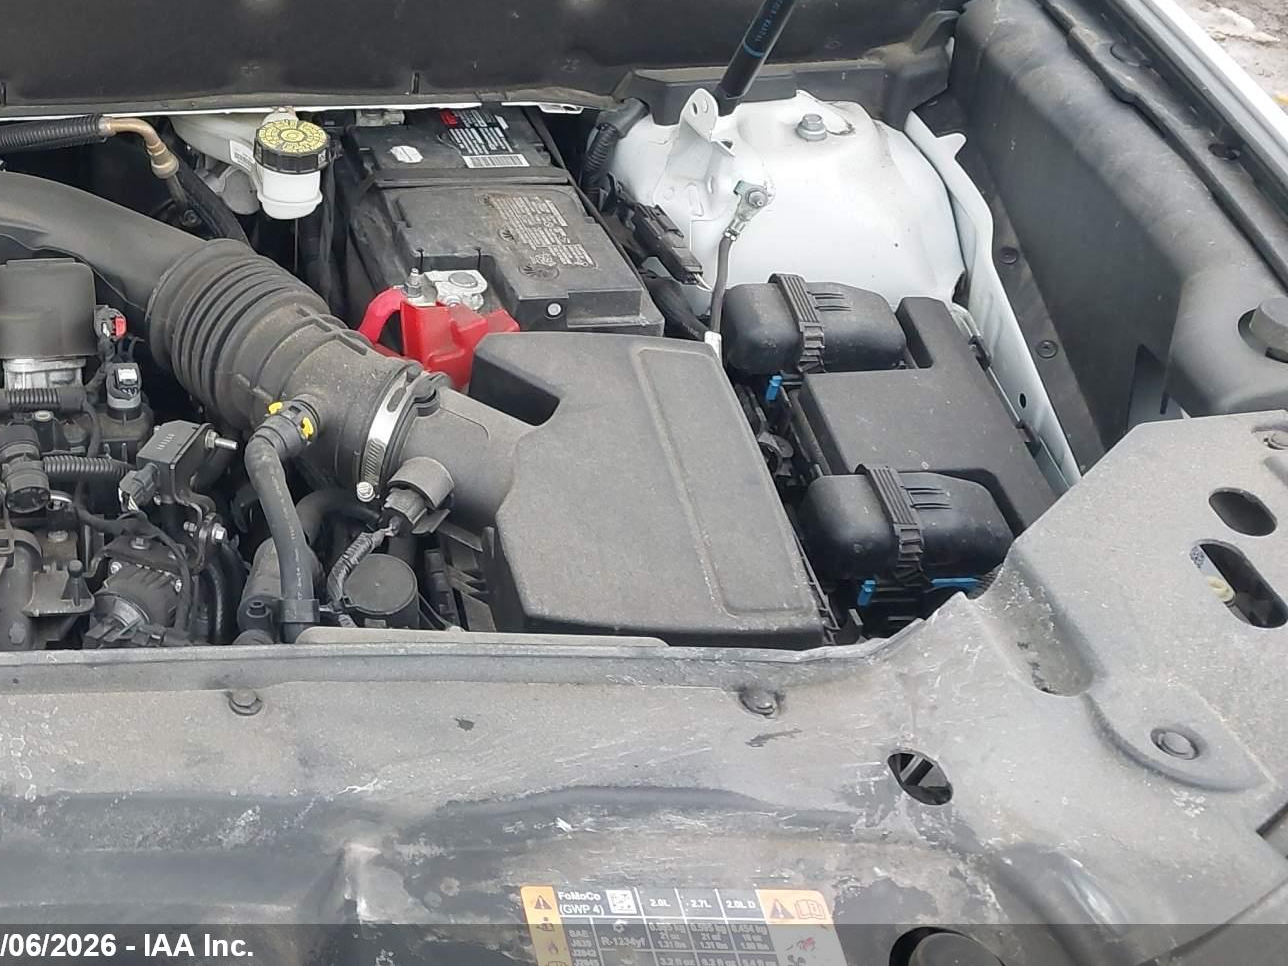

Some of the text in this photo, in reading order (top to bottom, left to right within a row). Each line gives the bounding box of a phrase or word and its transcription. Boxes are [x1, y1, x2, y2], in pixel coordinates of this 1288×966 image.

[558, 891, 601, 902] FoMoCo
[650, 898, 671, 908] 2.0L
[690, 898, 712, 908] 2.7L
[559, 903, 605, 916] (GWP 4)
[600, 936, 646, 948] R-1234yf
